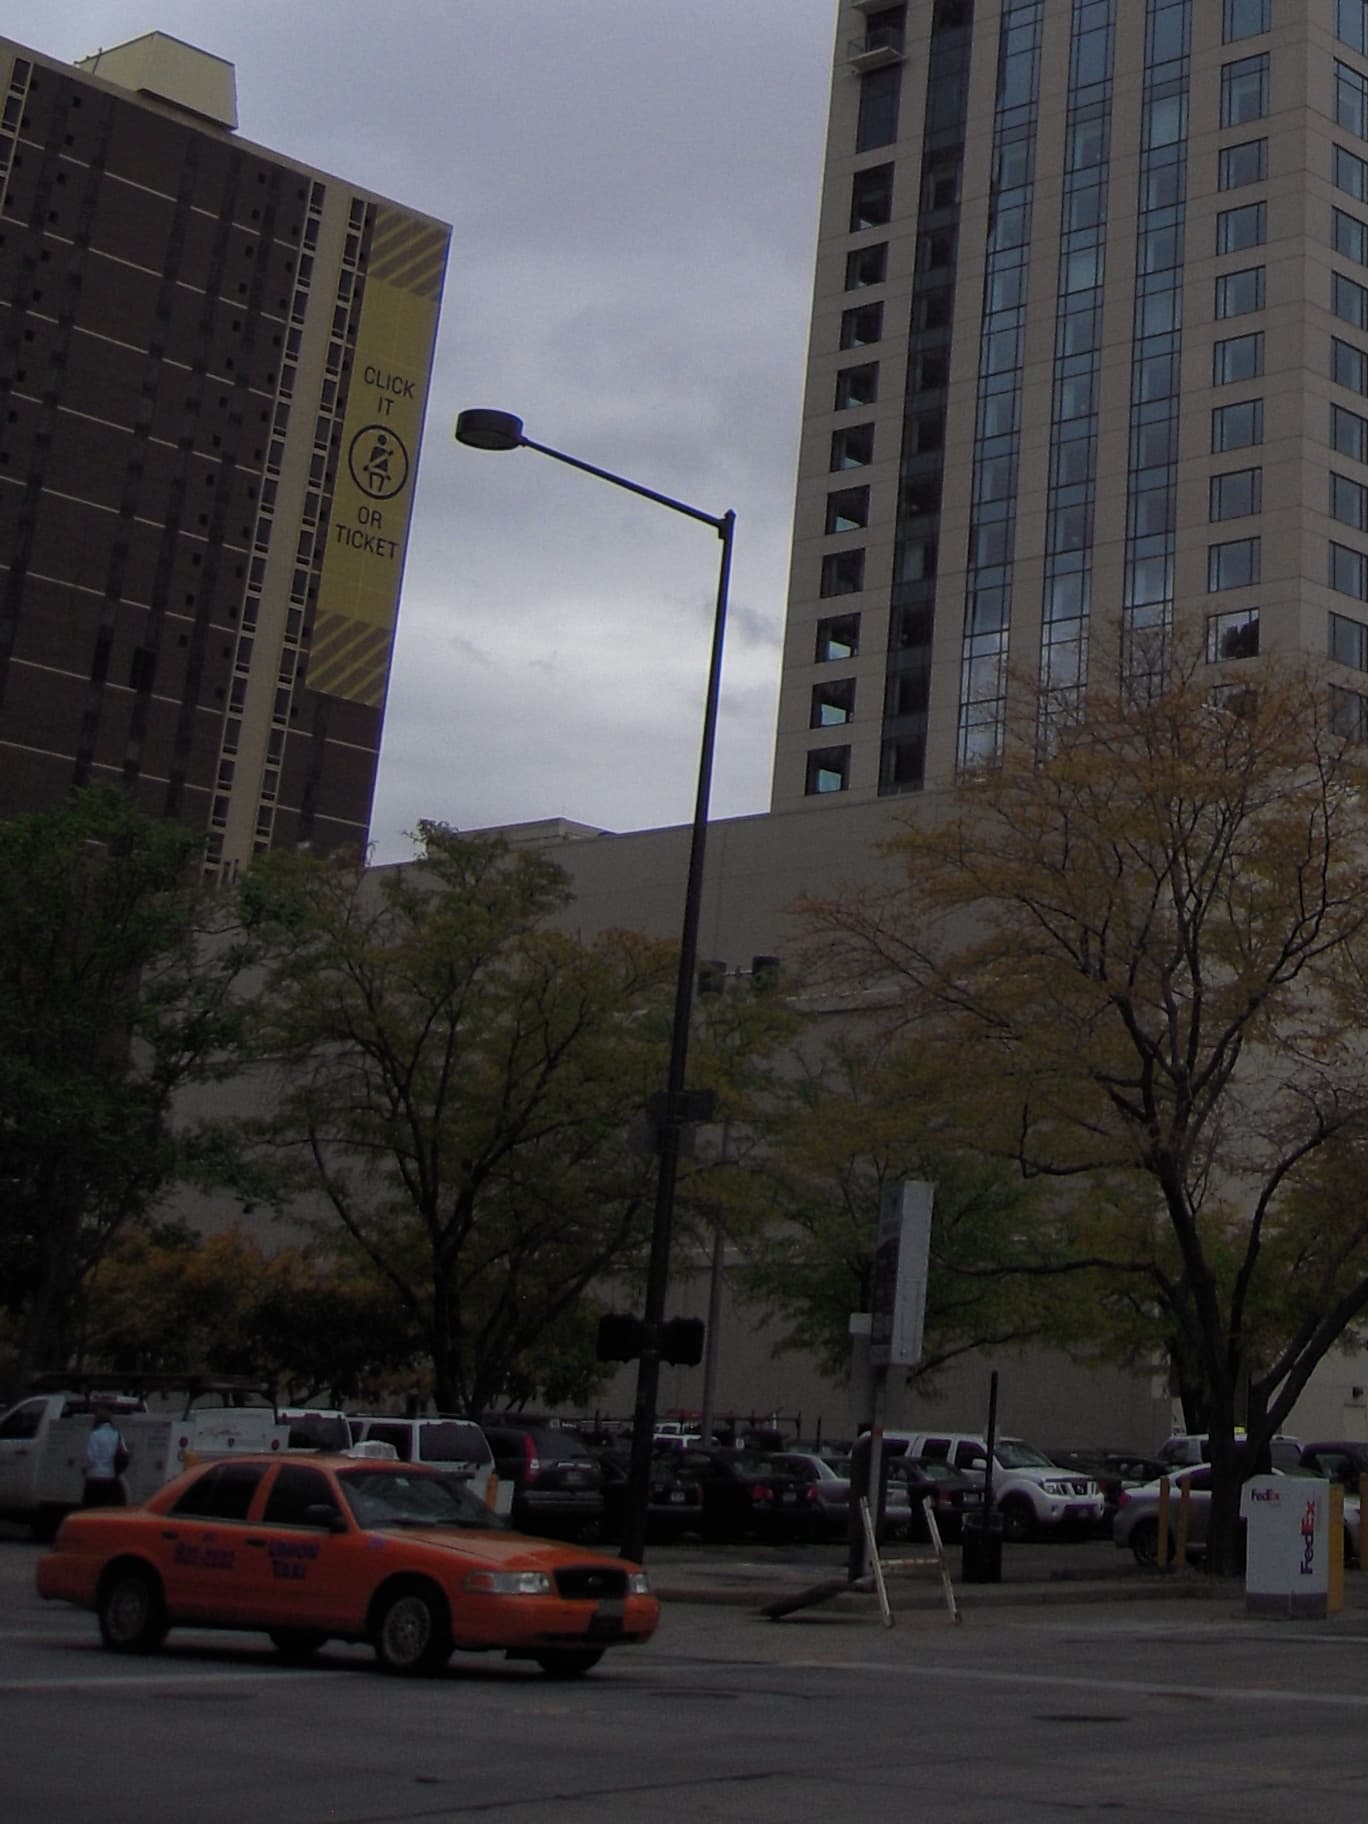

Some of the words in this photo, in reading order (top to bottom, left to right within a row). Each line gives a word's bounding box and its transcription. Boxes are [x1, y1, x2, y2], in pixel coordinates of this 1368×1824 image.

[363, 366, 415, 399] CLICK
[377, 396, 394, 416] IT
[357, 506, 382, 529] OR
[335, 524, 400, 560] TICKET
[1250, 1488, 1280, 1501] FedEx
[1300, 1500, 1315, 1574] FedEx
